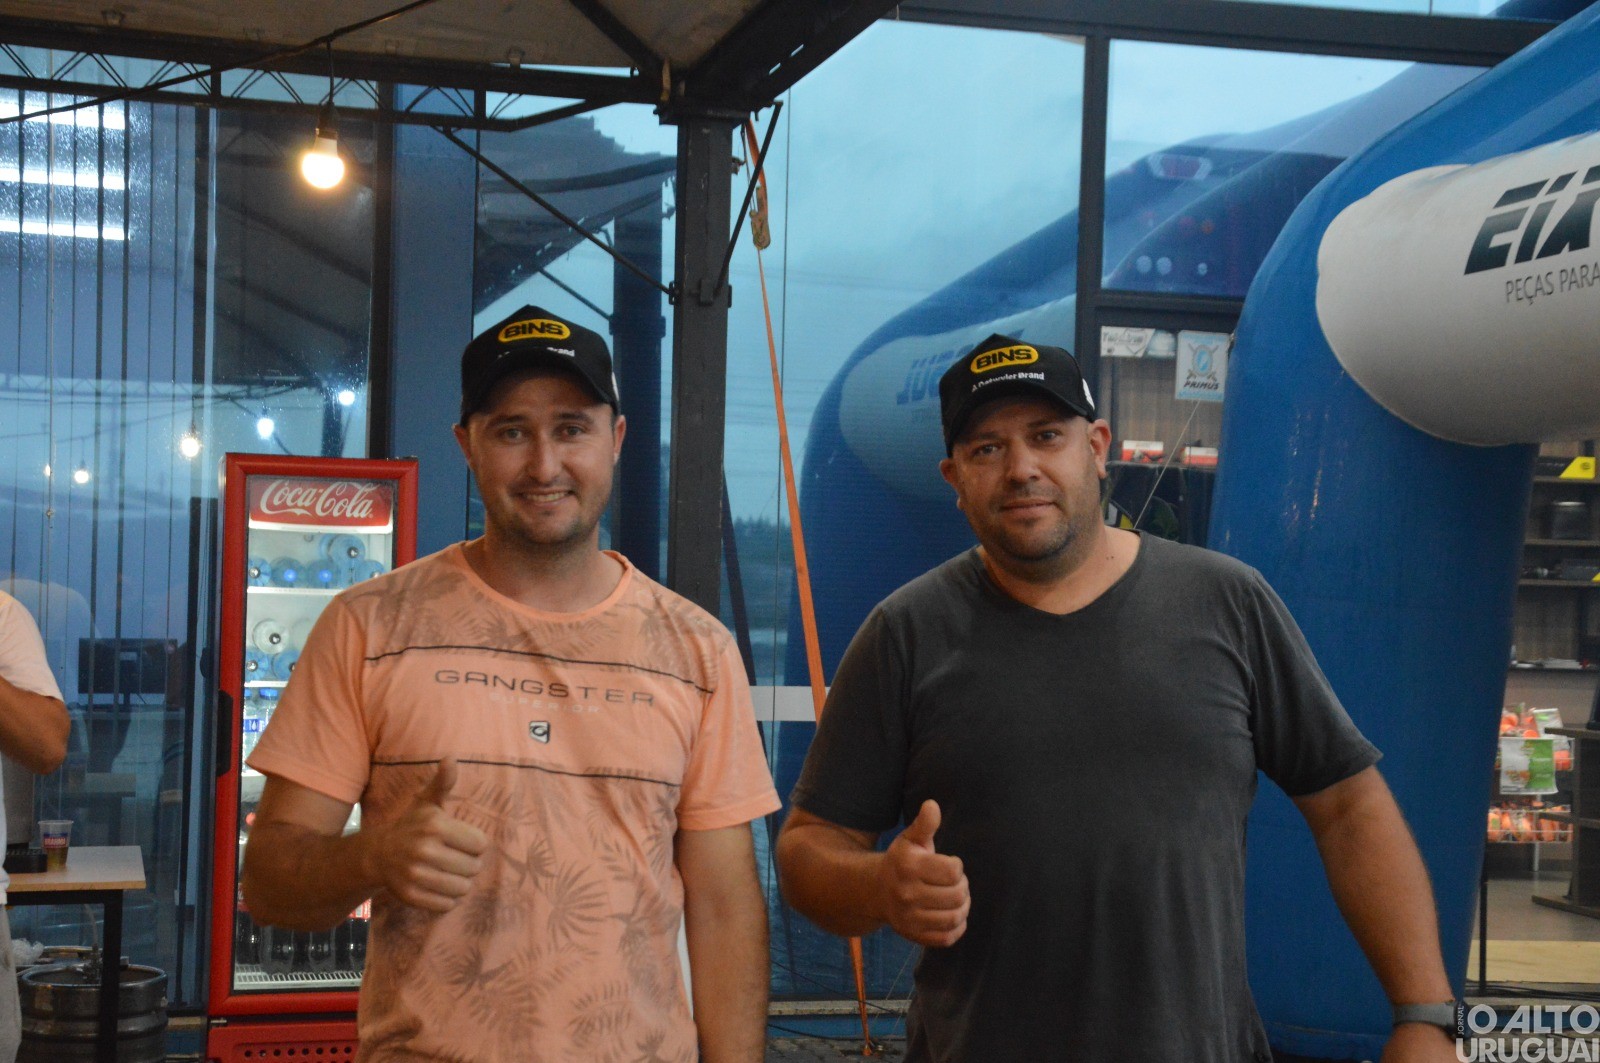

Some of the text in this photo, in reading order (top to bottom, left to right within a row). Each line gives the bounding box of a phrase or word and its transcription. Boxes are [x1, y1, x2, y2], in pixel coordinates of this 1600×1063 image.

[1505, 262, 1600, 305] PEÇAS PARA
[504, 321, 564, 339] BINS
[976, 348, 1032, 369] BINS
[1183, 380, 1219, 390] PRIMUS
[260, 479, 379, 519] Coca-Cola
[434, 669, 655, 707] GANGSTER
